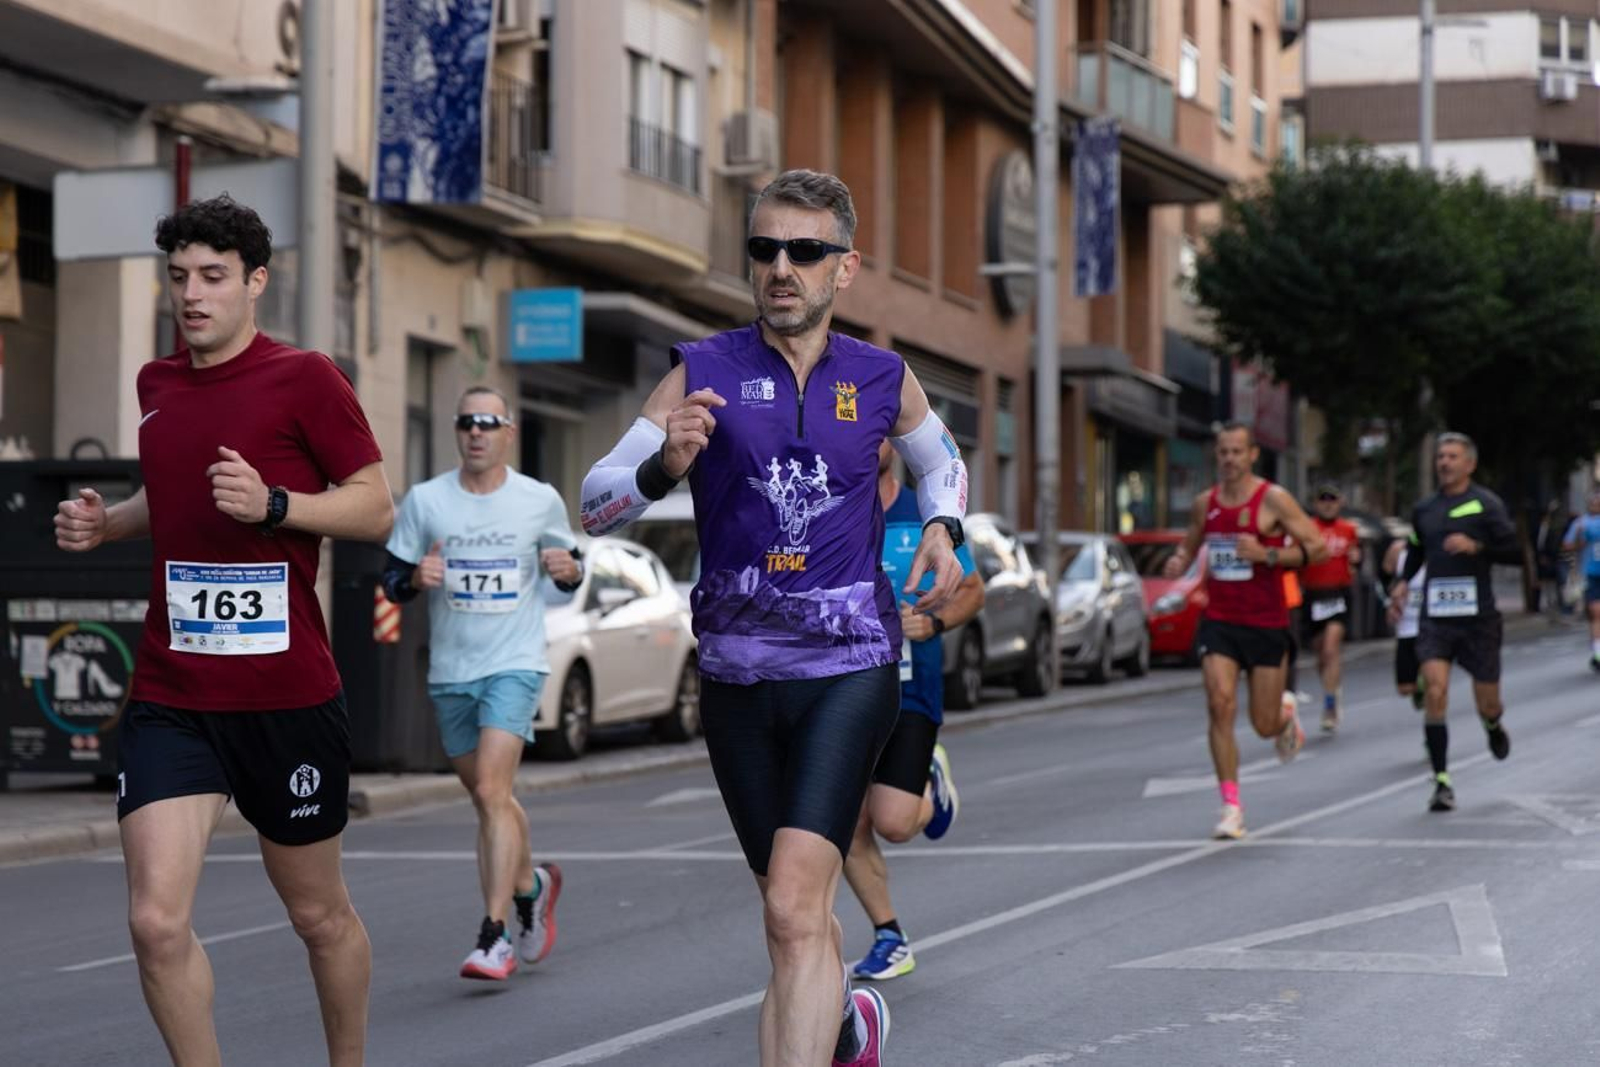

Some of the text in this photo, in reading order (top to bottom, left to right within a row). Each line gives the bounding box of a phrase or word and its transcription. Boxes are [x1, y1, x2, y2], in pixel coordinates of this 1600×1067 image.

[741, 391, 764, 400] MAR
[767, 553, 806, 573] TRAIL
[460, 573, 503, 592] 171
[191, 589, 263, 620] 163
[212, 623, 238, 631] JAVIER
[290, 804, 321, 819] vive
